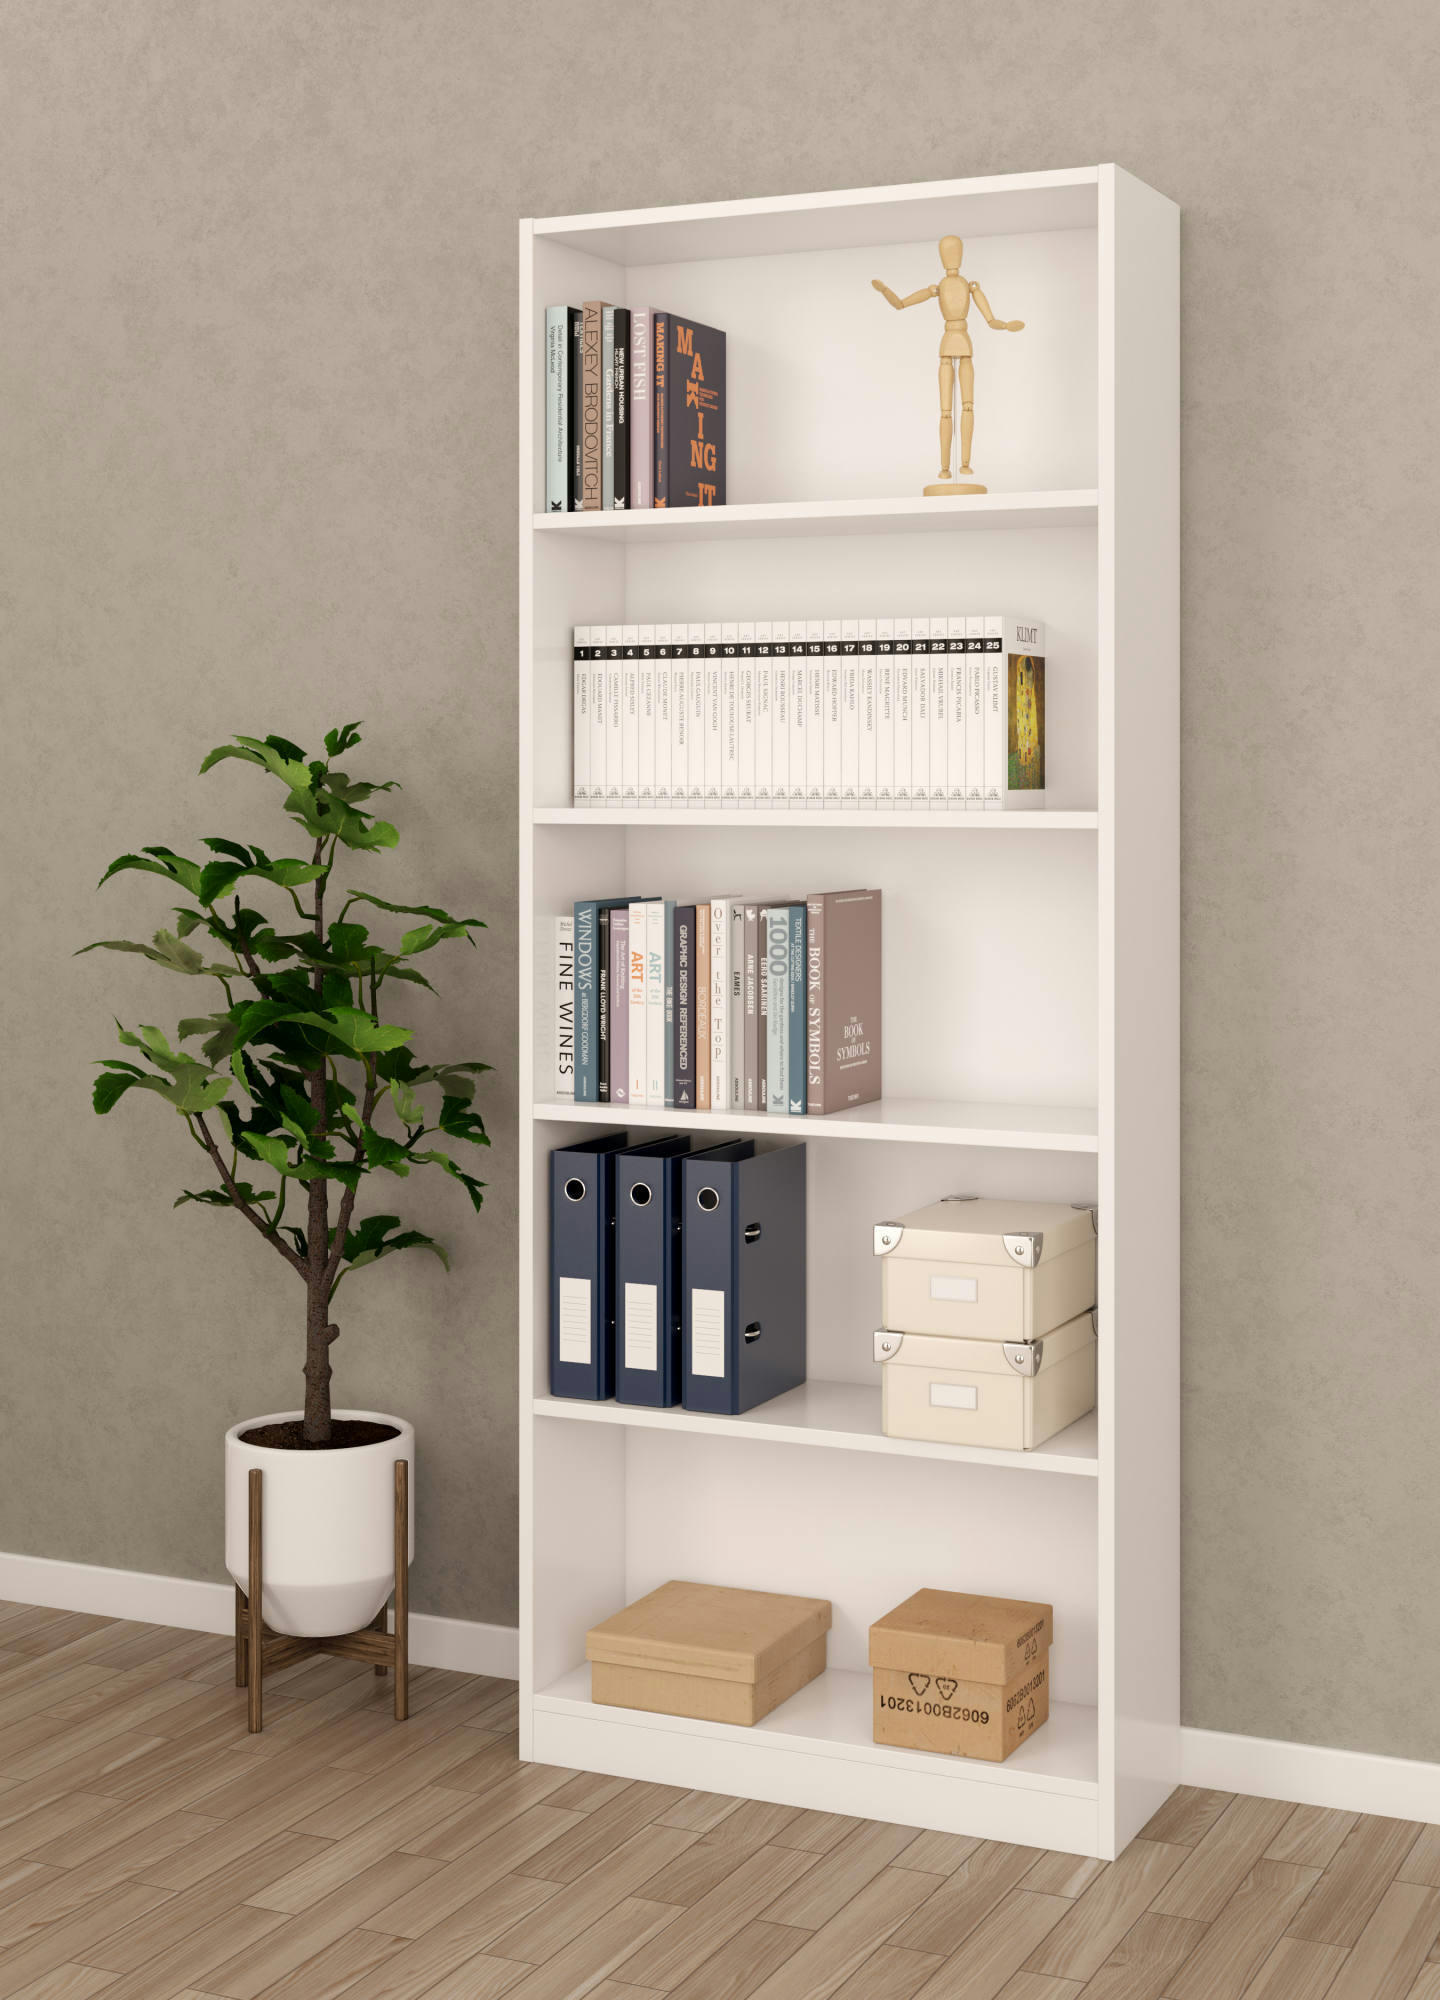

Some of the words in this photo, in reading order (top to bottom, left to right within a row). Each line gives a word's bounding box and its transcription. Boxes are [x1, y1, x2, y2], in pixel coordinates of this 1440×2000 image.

[585, 307, 598, 376] ALEXEY
[633, 313, 646, 359] LOST
[656, 322, 664, 372] MAKING
[633, 362, 646, 400] FISH
[656, 375, 664, 387] IT
[606, 412, 613, 421] in
[585, 383, 598, 500] BRODOVITCH
[1016, 626, 1038, 644] KLIMT
[610, 649, 617, 657] 3
[643, 648, 650, 656] 5
[660, 648, 666, 656] 6
[709, 647, 716, 655] 9
[758, 646, 769, 654] 12
[826, 644, 838, 652] 16
[844, 644, 855, 652] 17
[861, 644, 873, 652] 18
[879, 643, 890, 651] 19
[896, 643, 910, 651] 20
[915, 643, 927, 651] 21
[932, 642, 945, 650] 22
[950, 642, 964, 650] 23
[968, 642, 981, 650] 24
[986, 641, 1000, 650] 25
[577, 909, 592, 990] WINDOWS
[679, 925, 687, 968] GRAPHIC
[769, 917, 787, 976] 1000
[559, 942, 573, 991] FINE
[631, 951, 643, 982] ART
[649, 952, 661, 983] ART
[809, 947, 820, 991] BOOK
[679, 970, 687, 1005] DESIGN
[809, 995, 815, 1004] OF
[697, 986, 707, 1040] BORDEAUX
[559, 1002, 573, 1074] WINES
[679, 1008, 687, 1070] REFERENCED
[844, 1023, 864, 1039] BOOK
[808, 1007, 820, 1085] SYMBOLS
[836, 1041, 871, 1061] SYMBOLS
[880, 1695, 990, 1725] 6062B0013201
